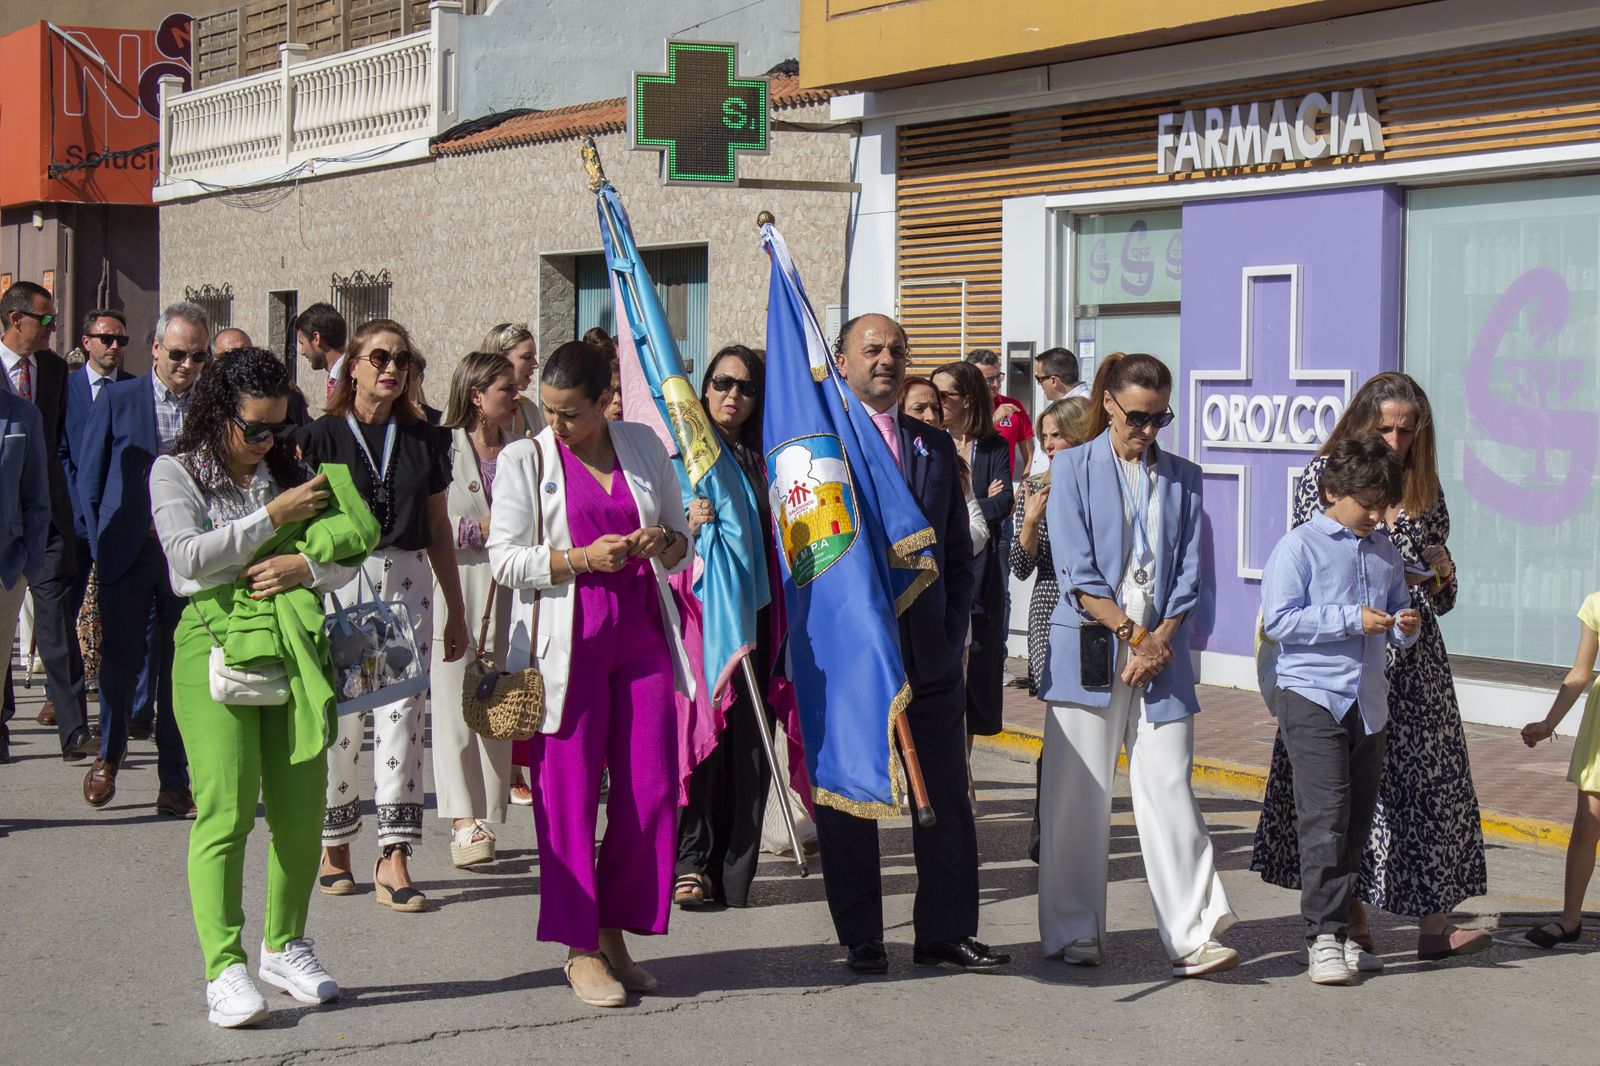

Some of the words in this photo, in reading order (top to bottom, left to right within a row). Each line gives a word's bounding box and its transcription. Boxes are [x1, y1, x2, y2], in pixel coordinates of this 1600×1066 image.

[1157, 87, 1382, 174] FARMACIA
[66, 145, 160, 170] Soluci
[1202, 393, 1345, 444] OROZCO
